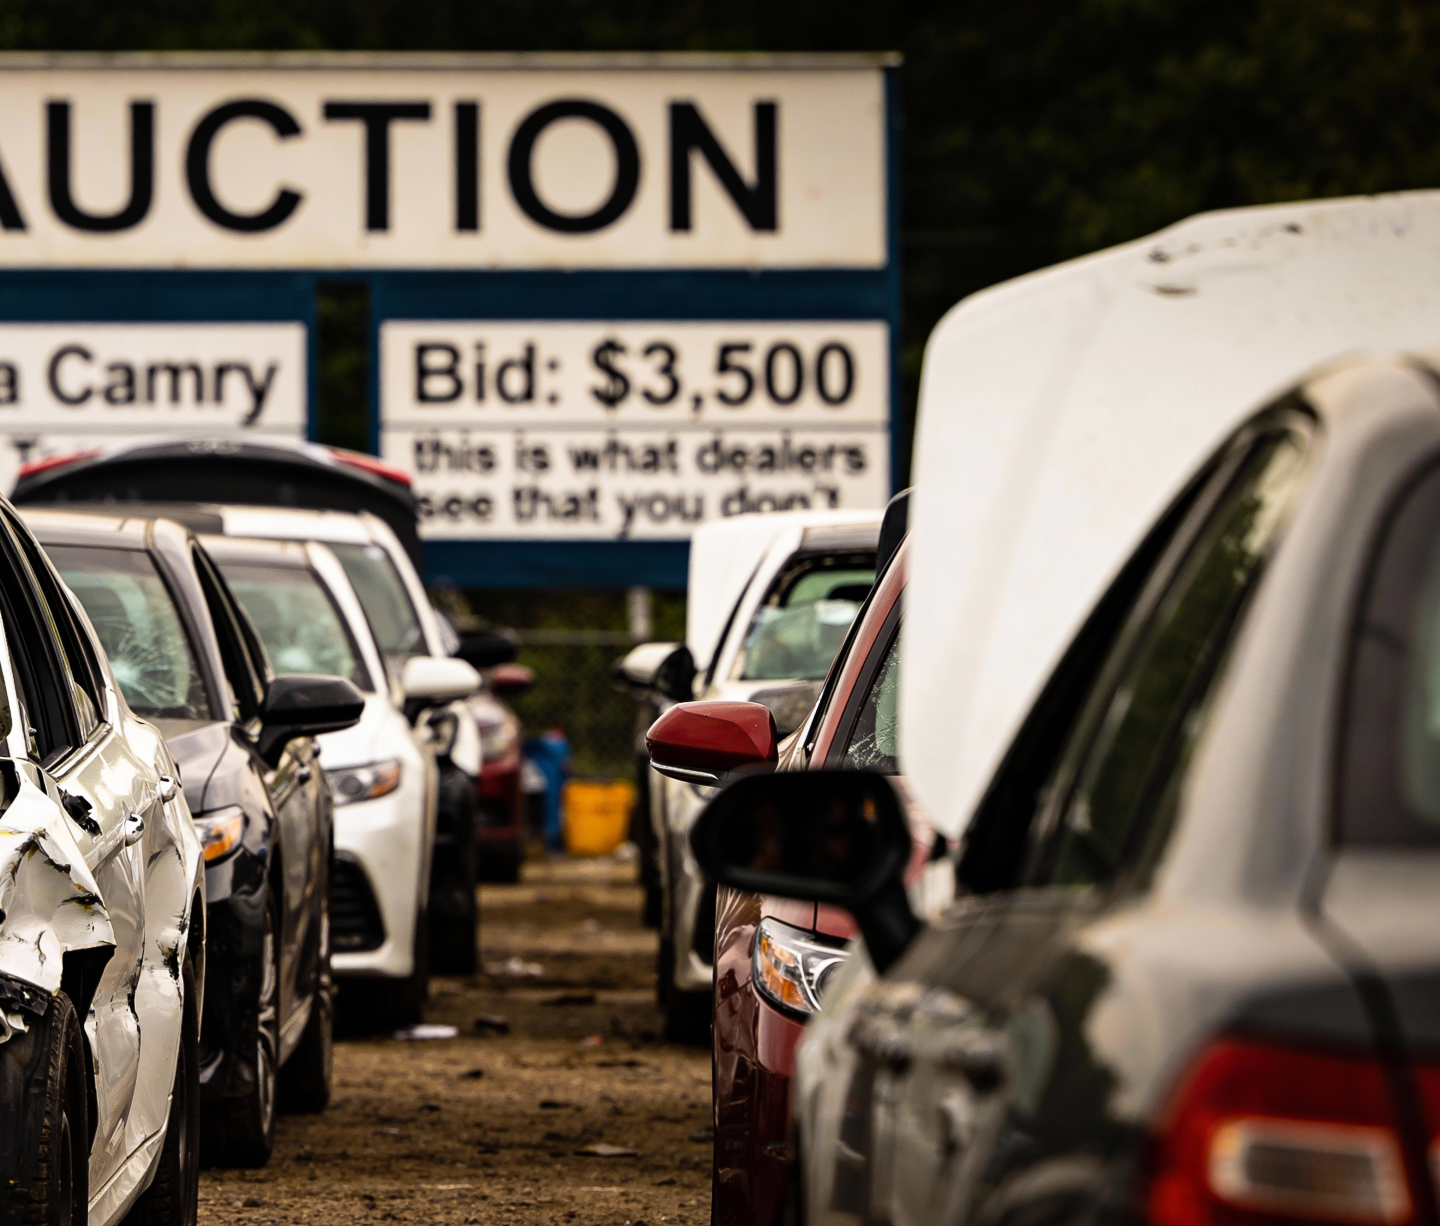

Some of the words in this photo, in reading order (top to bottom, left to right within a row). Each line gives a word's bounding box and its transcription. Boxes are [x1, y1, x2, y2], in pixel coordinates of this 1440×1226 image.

[47, 343, 278, 426] Camry
[414, 341, 559, 406] Bid:
[590, 337, 857, 420] $3,500
[414, 430, 496, 473] this
[515, 430, 550, 473] is
[568, 430, 678, 474] what
[696, 430, 867, 475] dealers
[418, 494, 493, 521] see
[513, 480, 599, 522] that
[613, 494, 704, 540] you
